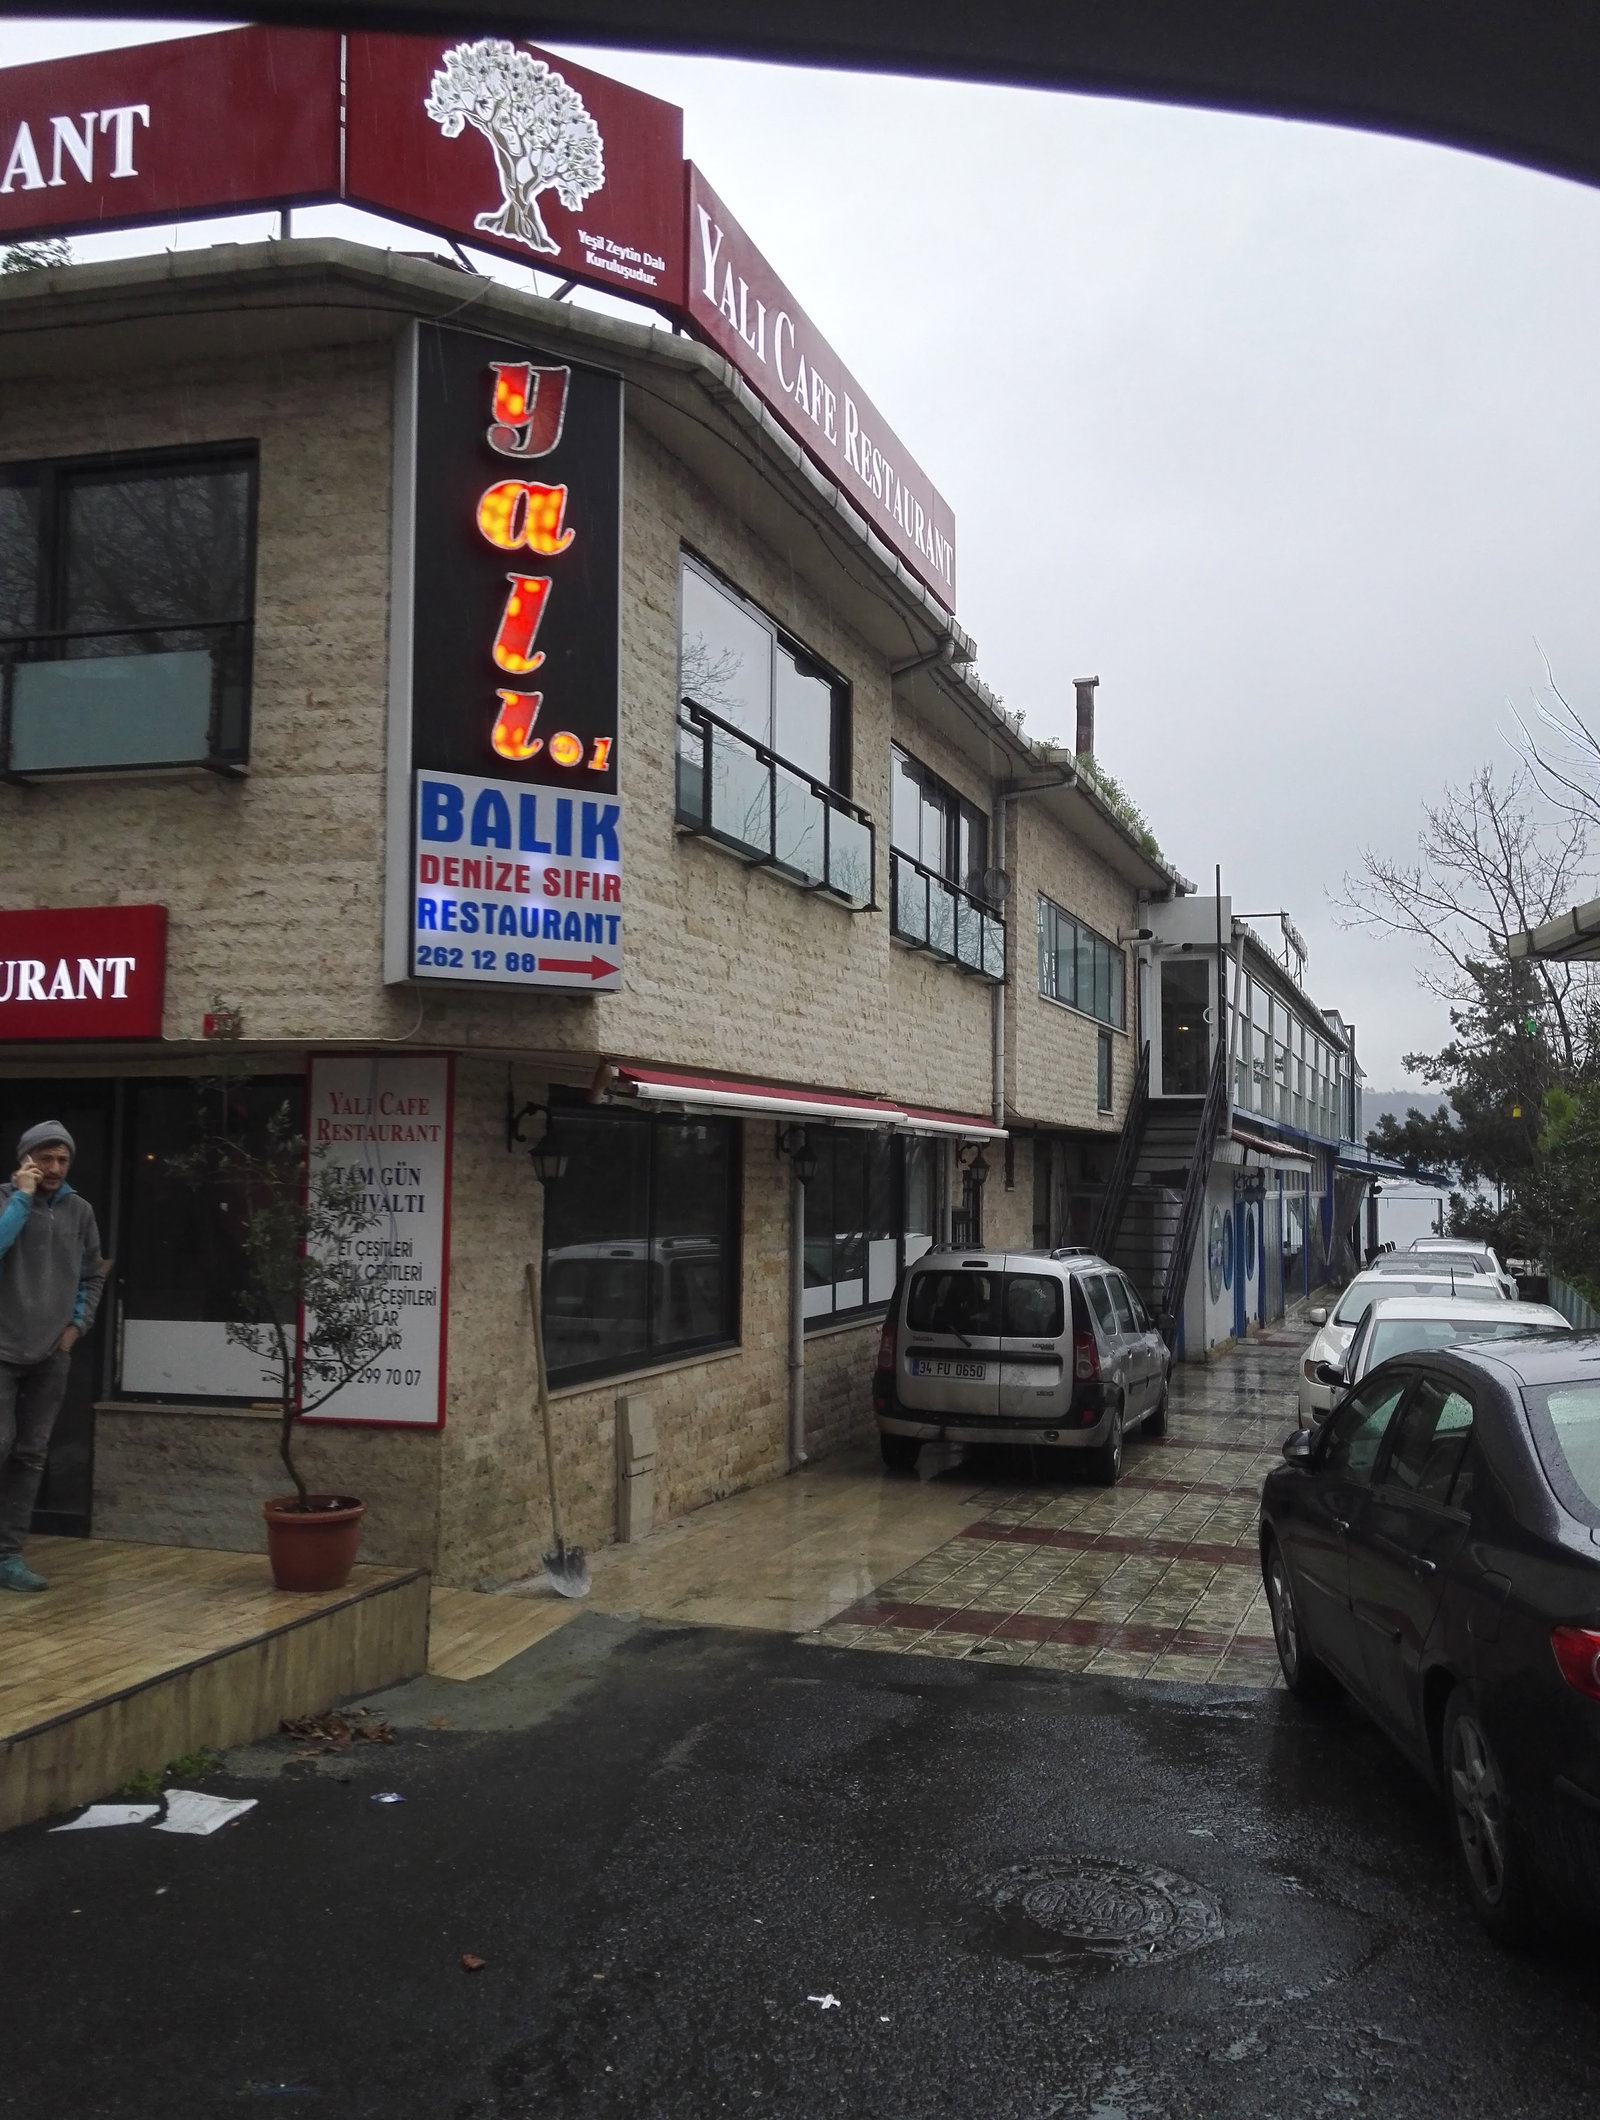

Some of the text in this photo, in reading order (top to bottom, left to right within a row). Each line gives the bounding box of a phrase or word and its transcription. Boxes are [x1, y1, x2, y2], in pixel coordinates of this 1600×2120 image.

[0, 104, 150, 193] ANT
[578, 229, 665, 271] Yeşil Zeytin Dalı
[586, 250, 657, 286] Kuruluşudur.
[697, 203, 954, 587] YALI CAFE RESTAURANT
[420, 780, 621, 861] BALIK
[420, 854, 621, 903] DENİZE SIFIR
[417, 897, 621, 945] RESTAURANT
[417, 945, 536, 973] 262 12 88
[379, 1092, 430, 1116] CAFE
[316, 1118, 441, 1142] RESTAURANT
[381, 1161, 421, 1187] GÜN
[355, 1237, 413, 1260] ÇEŞİTLERİ
[379, 1286, 437, 1309] ÇEŞİTLERİ
[357, 1368, 382, 1385] 299
[386, 1369, 402, 1386] 70
[405, 1371, 422, 1387] 07
[919, 1361, 984, 1378] 34 FU 0650
